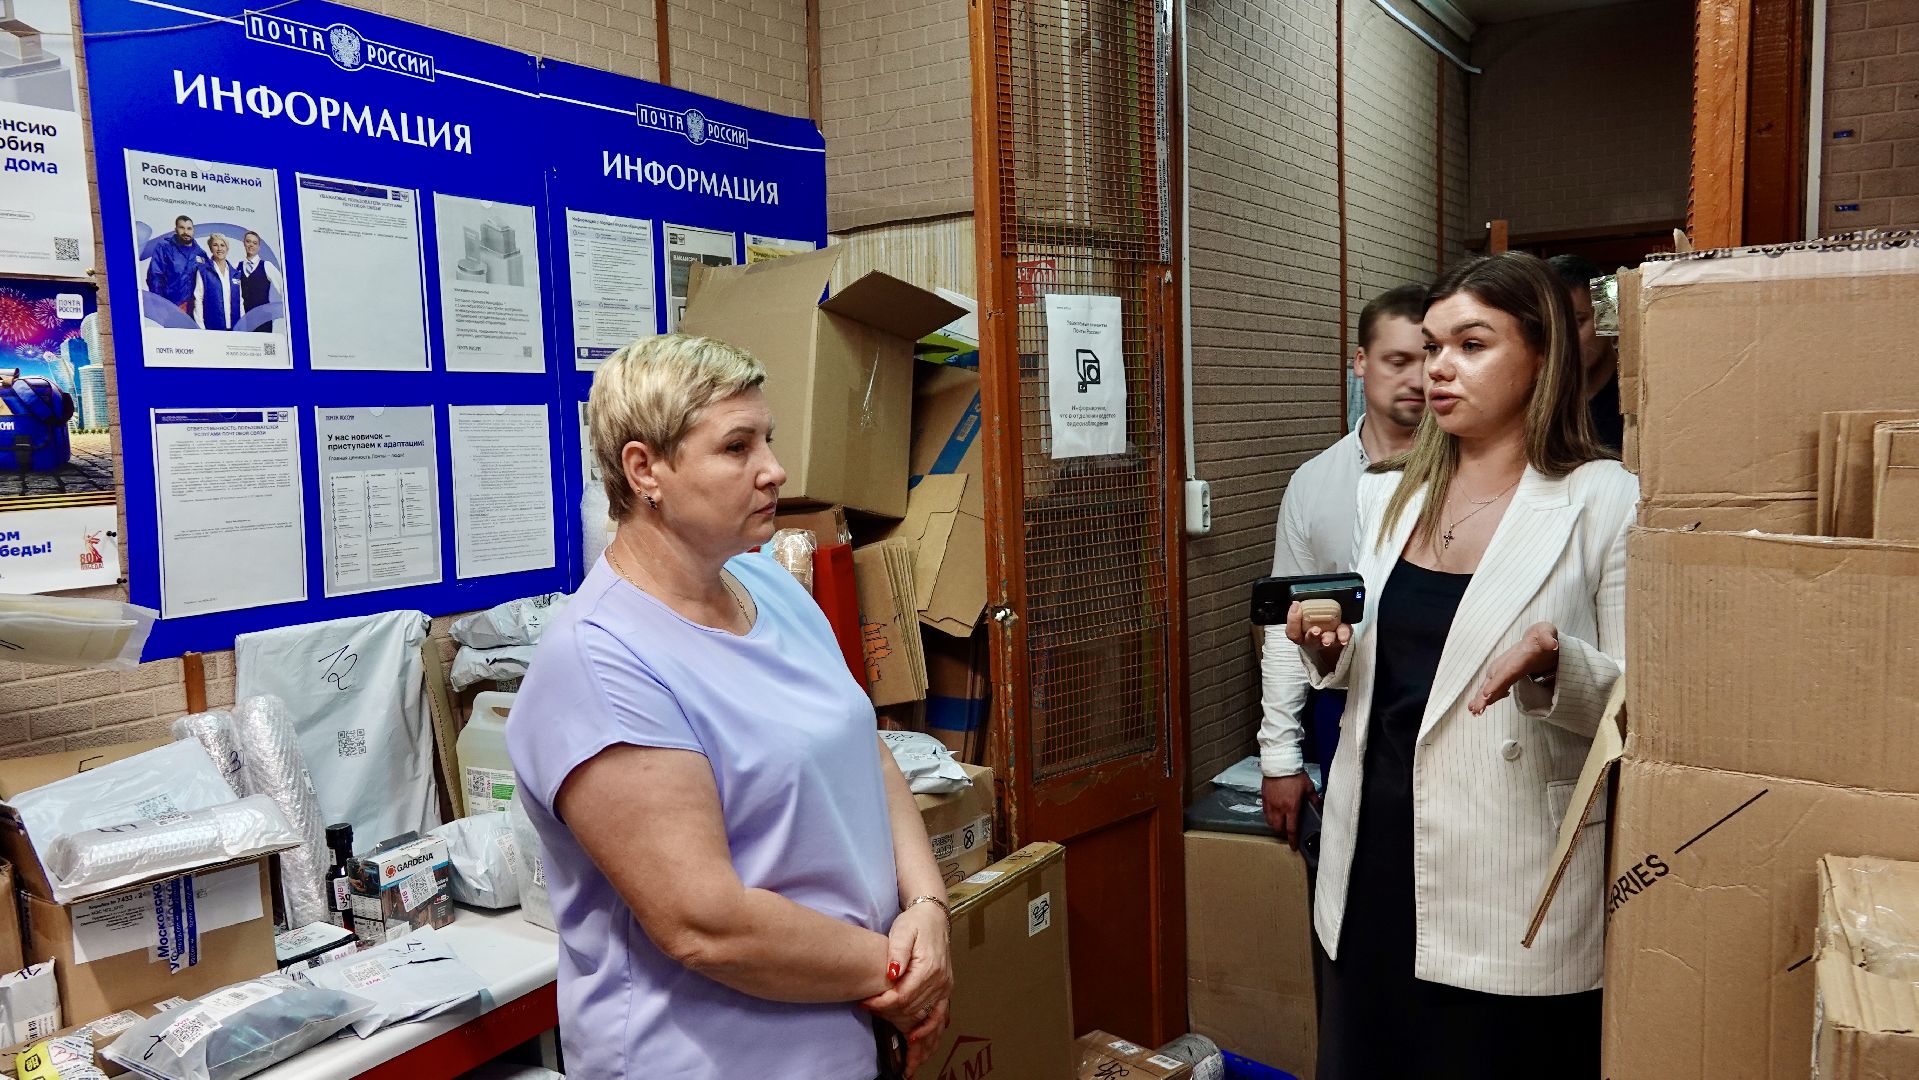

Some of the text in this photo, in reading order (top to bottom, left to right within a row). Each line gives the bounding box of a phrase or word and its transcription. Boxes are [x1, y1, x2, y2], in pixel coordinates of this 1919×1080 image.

[251, 16, 430, 77] ПОЧТА РОССИИ
[173, 69, 472, 155] ИНФОРМАЦИЯ
[0, 118, 57, 137] нсию
[641, 108, 746, 146] ПОЧТА РОССИИ
[5, 157, 58, 174] дома
[141, 162, 262, 188] Работа в надёжной
[142, 177, 206, 193] компании
[602, 150, 779, 206] ИНФОРМАЦИЯ
[143, 194, 202, 207] Присоединяйтесь
[208, 202, 235, 212] команде
[236, 205, 256, 214] Почты
[59, 305, 82, 313] РОССИИ
[327, 434, 333, 442] У
[351, 433, 383, 441] новичок
[327, 442, 376, 451] приступаем
[383, 439, 425, 449] адаптации!
[80, 552, 92, 564] 80
[396, 852, 434, 873] GARDENA
